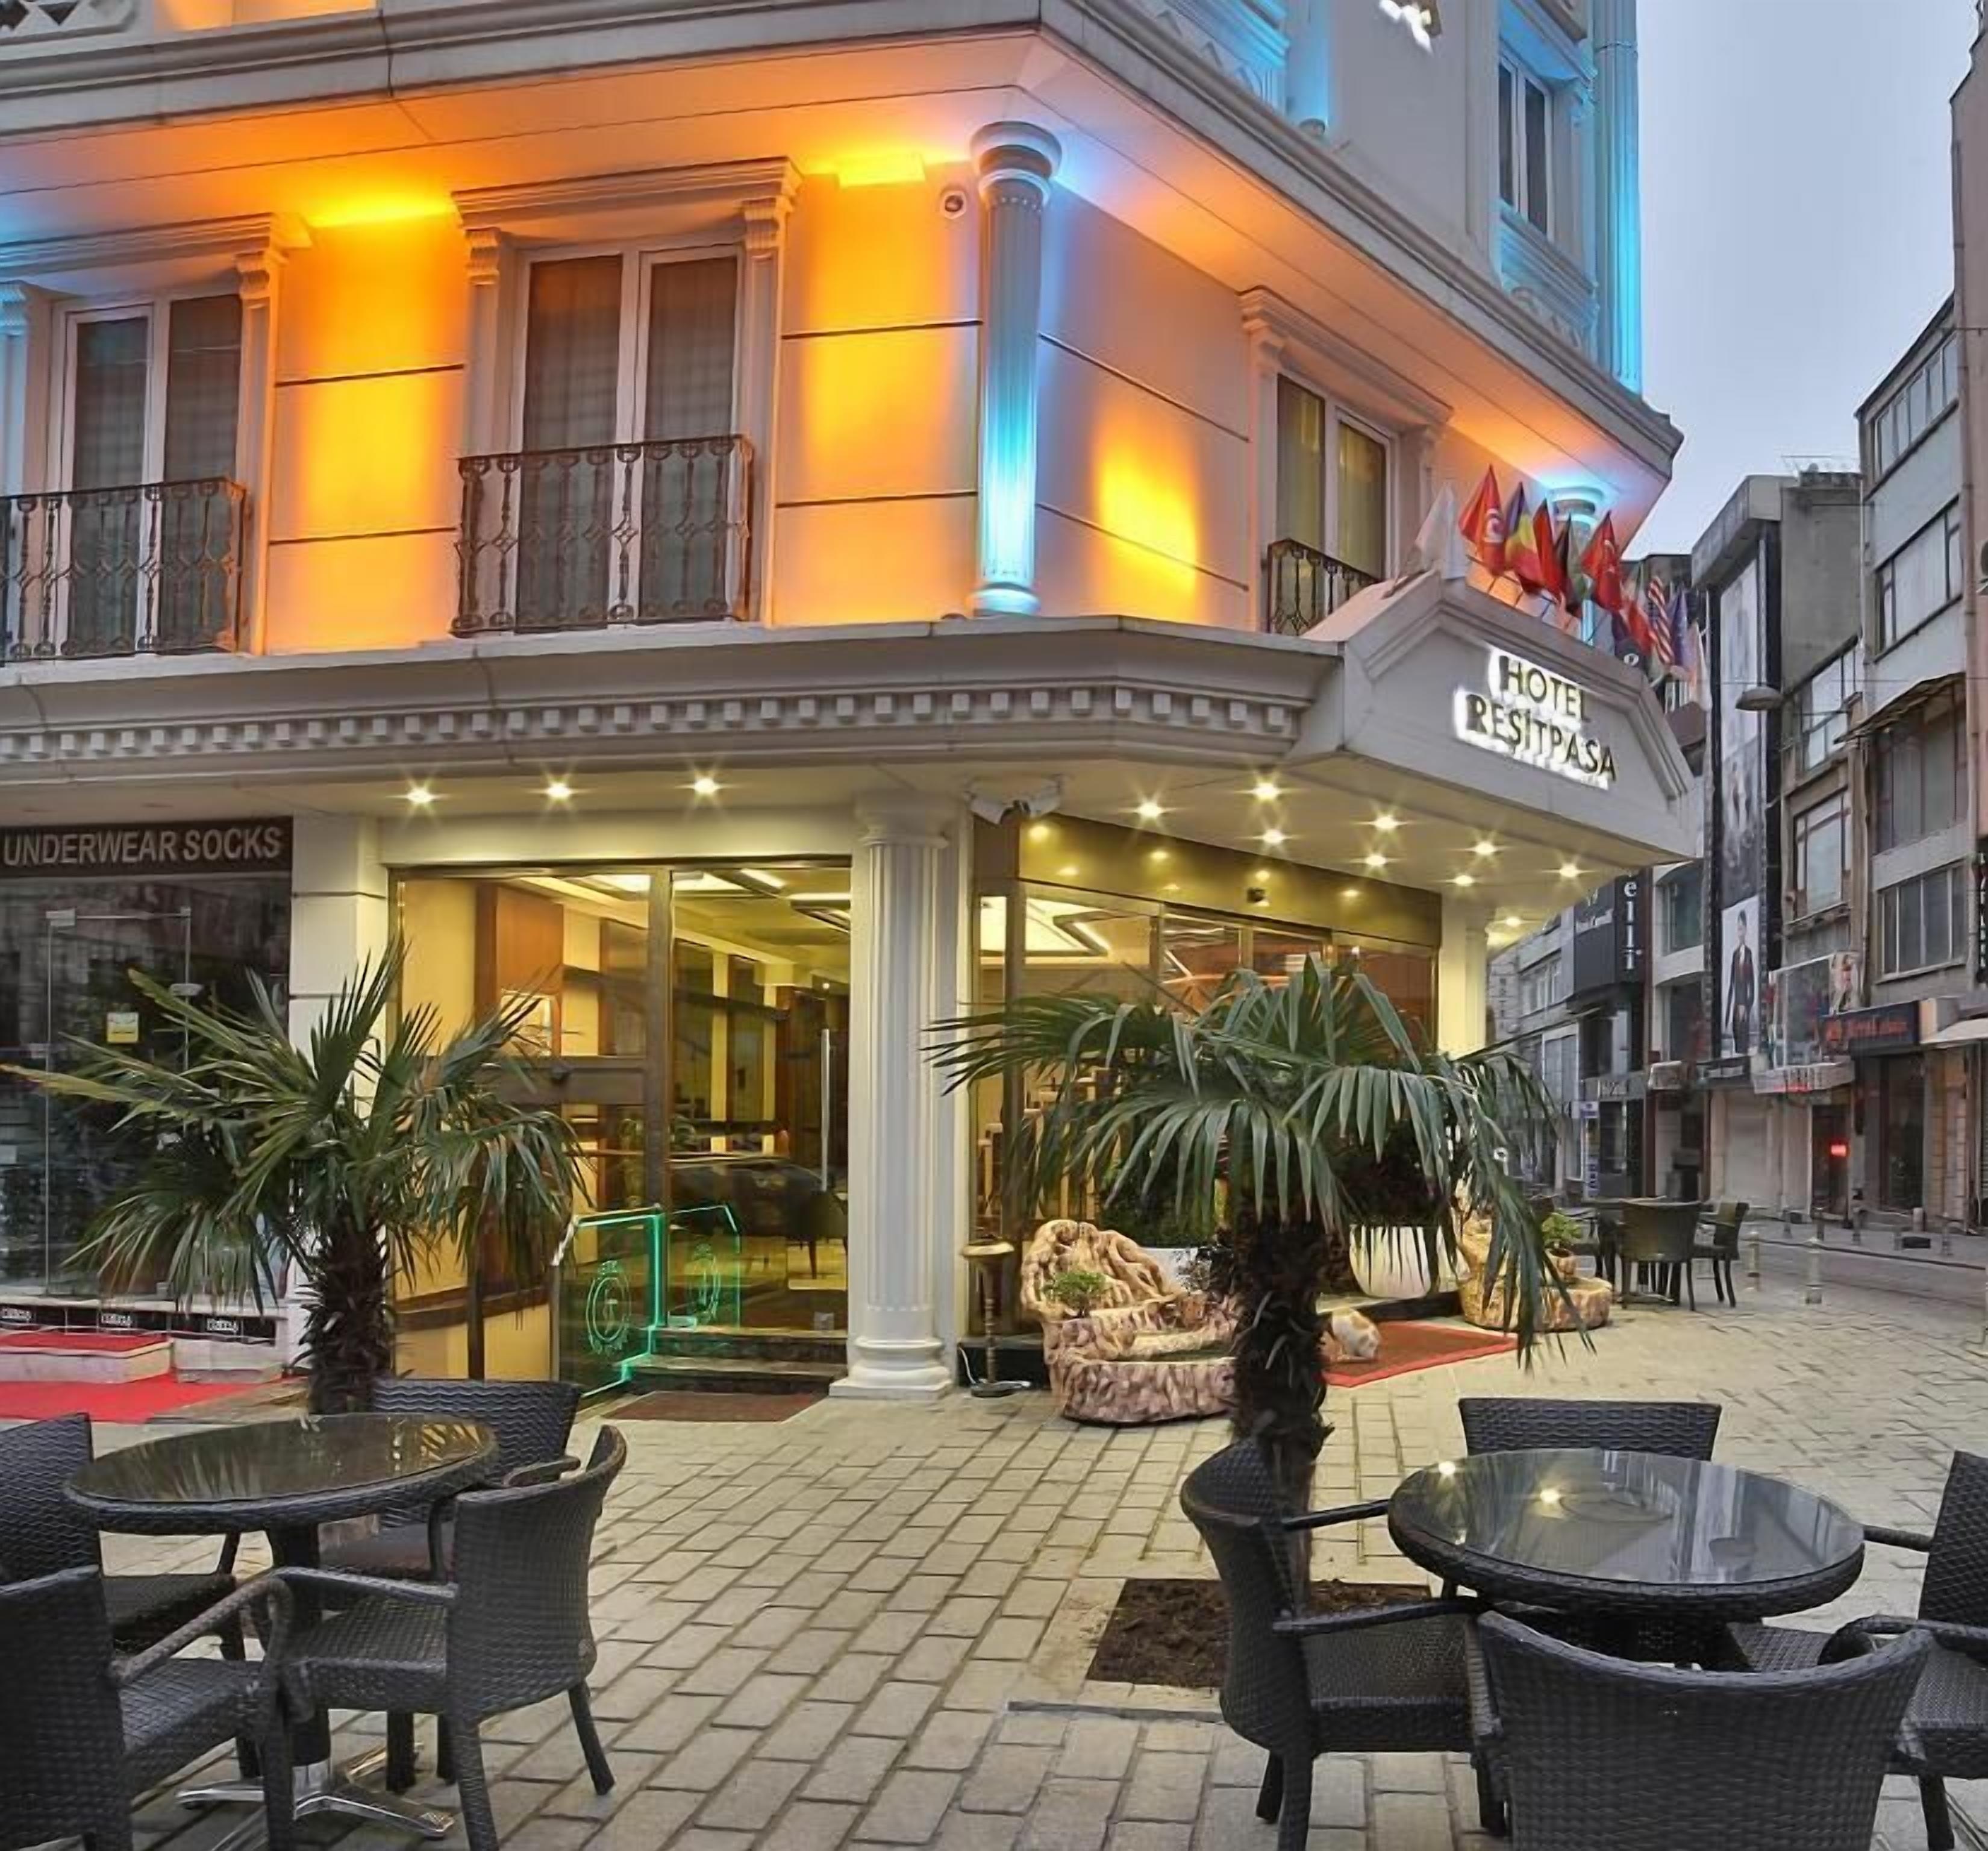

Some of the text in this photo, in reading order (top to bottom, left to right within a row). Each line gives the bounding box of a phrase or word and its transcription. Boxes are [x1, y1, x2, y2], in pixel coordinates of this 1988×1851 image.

[1498, 654, 1592, 722] HOTEL
[2, 826, 283, 866] UNDERWEAR SOCKS
